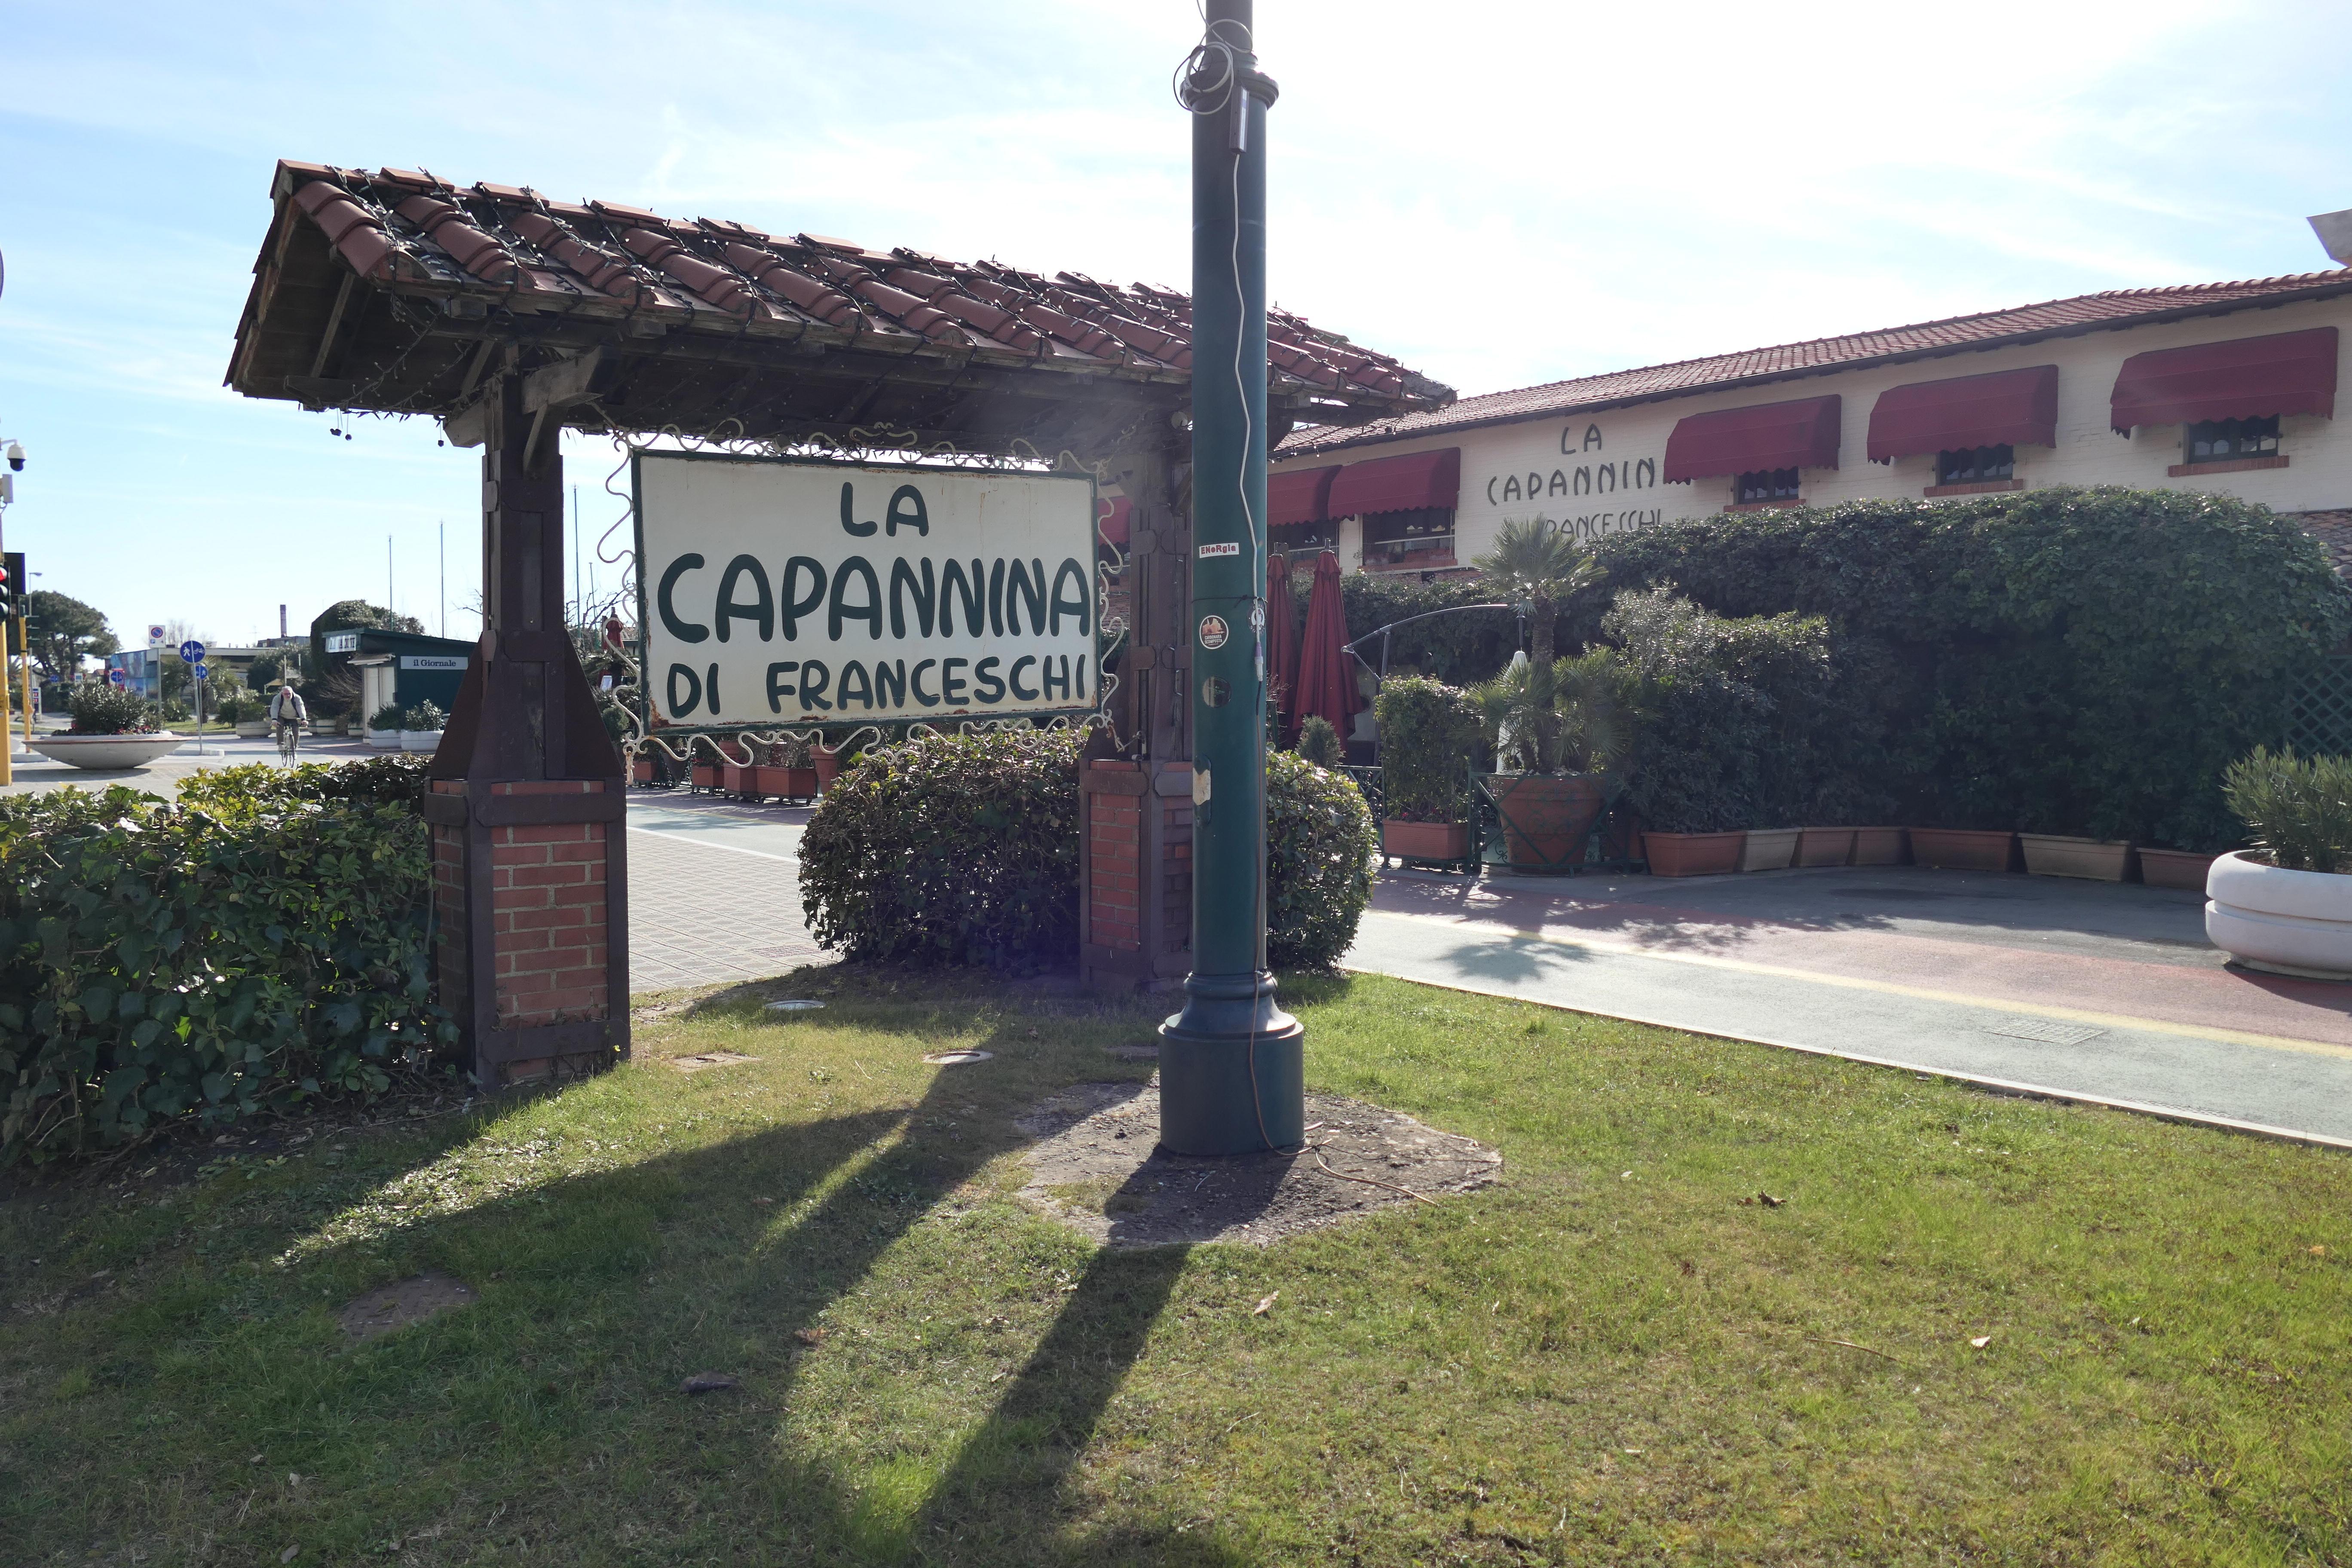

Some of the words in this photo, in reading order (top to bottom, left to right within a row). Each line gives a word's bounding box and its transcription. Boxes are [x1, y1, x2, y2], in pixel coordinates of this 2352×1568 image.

[1561, 423, 1602, 454] LA
[840, 481, 929, 537] LA
[1487, 457, 1655, 506] CAPANNIN
[657, 553, 1090, 644] CAPANNINA
[667, 662, 721, 719] DI
[766, 654, 1086, 714] FRANCESCHI
